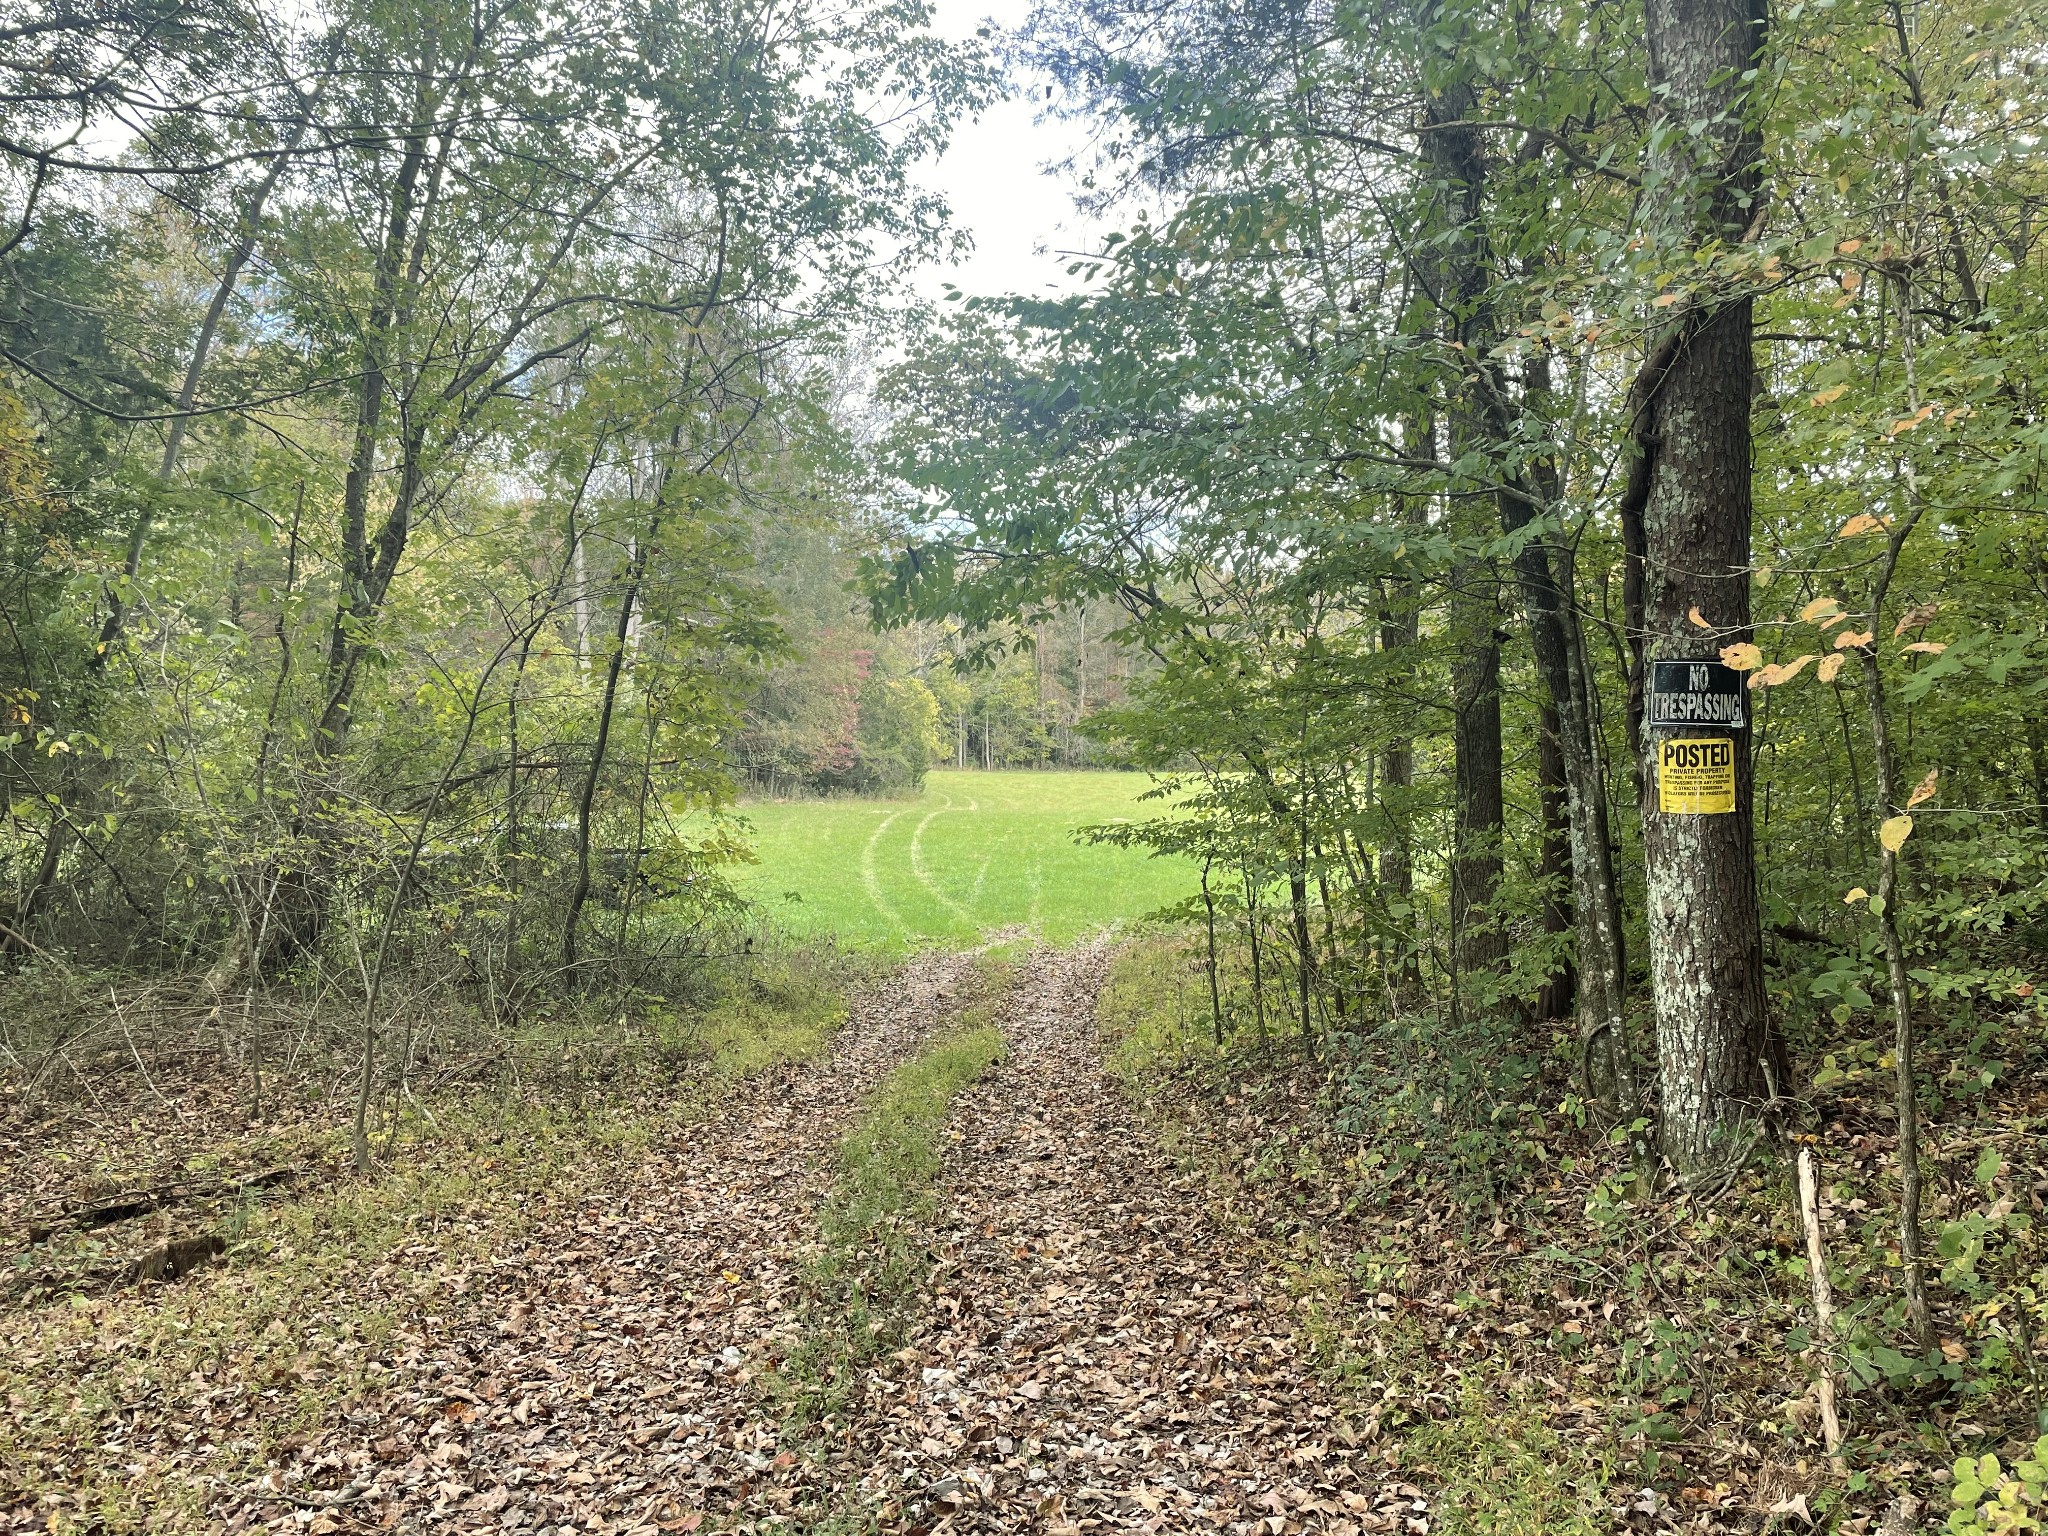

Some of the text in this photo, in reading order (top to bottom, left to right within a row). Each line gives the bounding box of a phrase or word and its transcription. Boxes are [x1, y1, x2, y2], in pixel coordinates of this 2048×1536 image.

[1689, 664, 1708, 691] NO
[1653, 692, 1740, 720] TRESPASSING
[1664, 744, 1730, 767] POSTED
